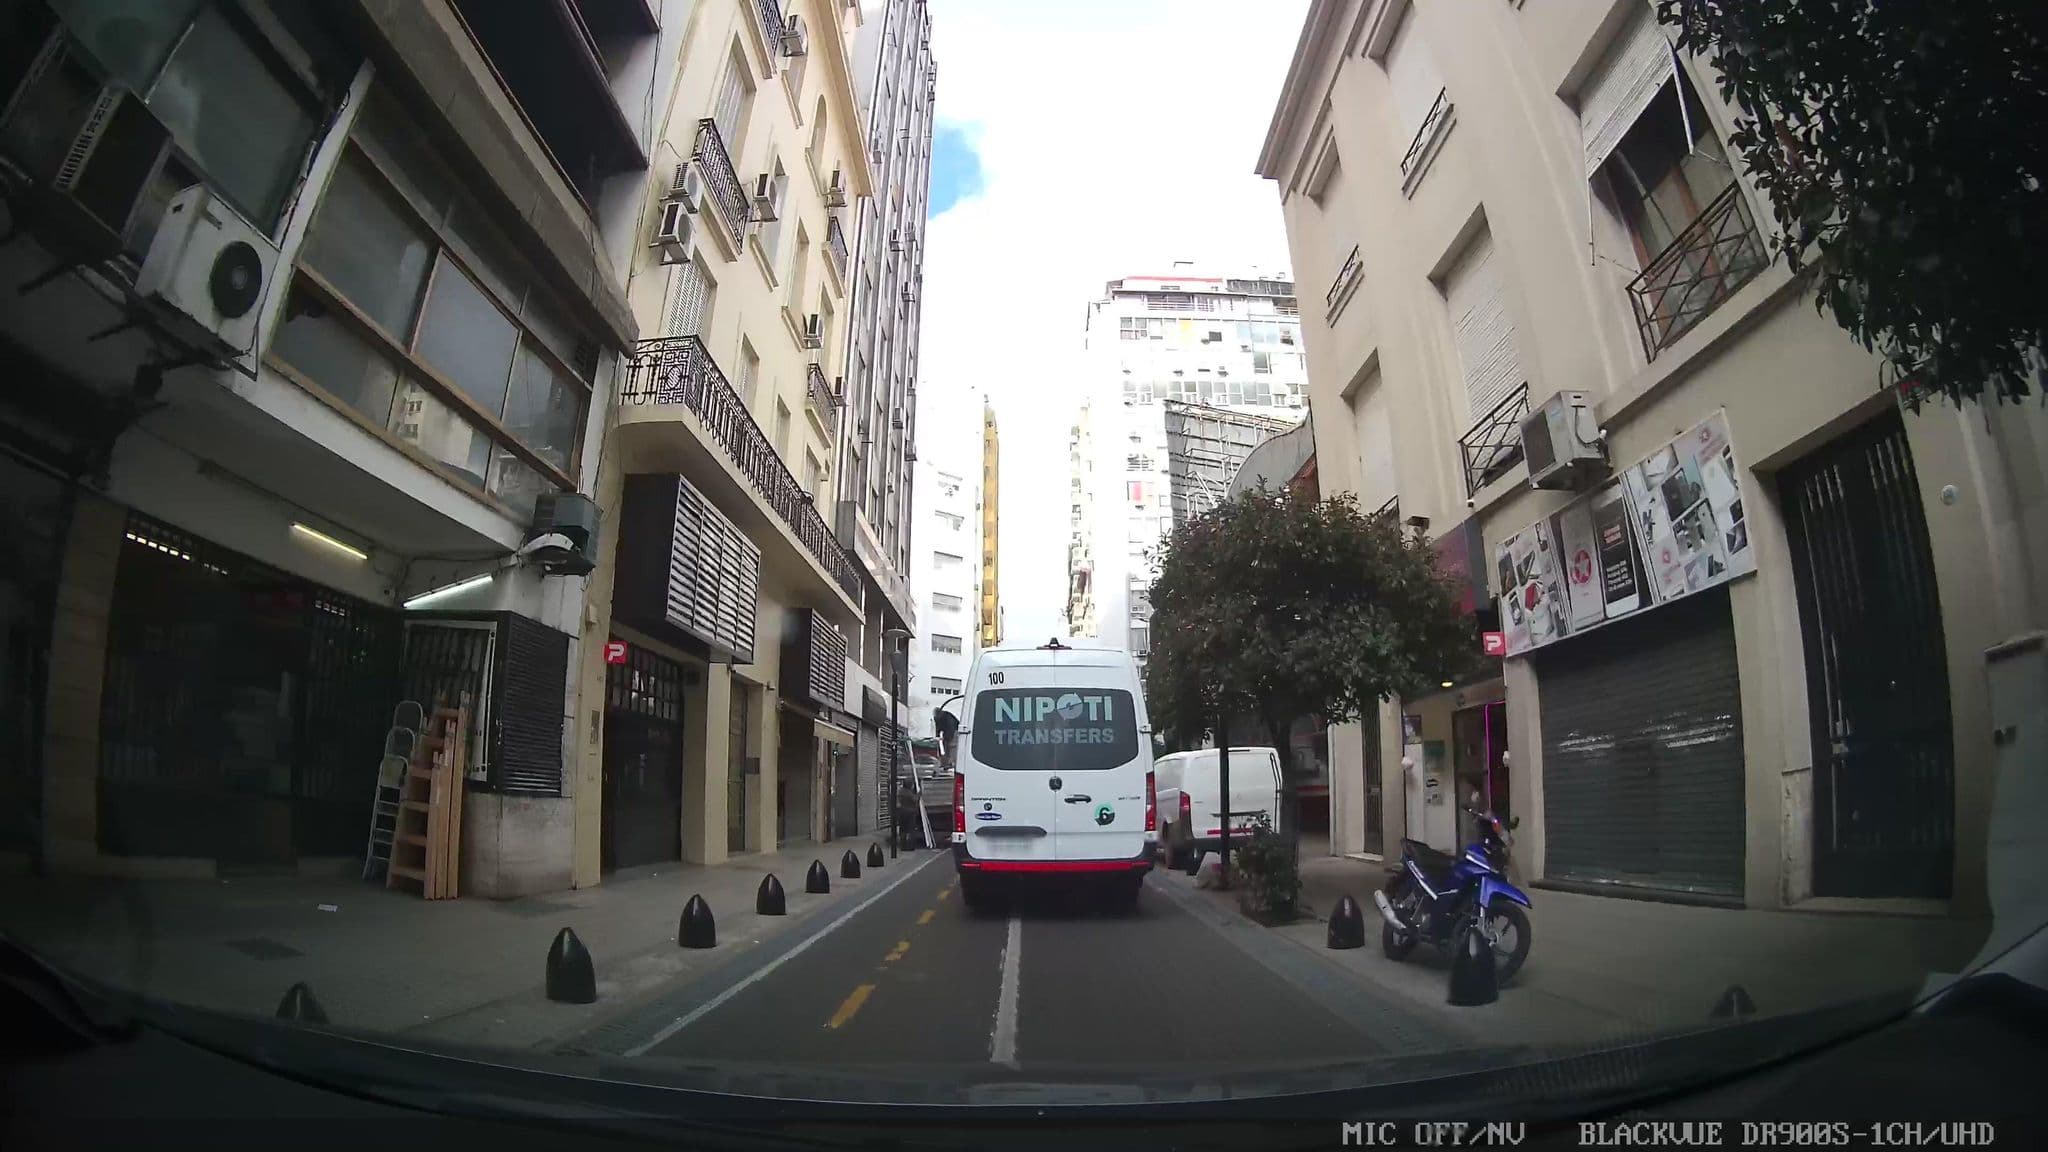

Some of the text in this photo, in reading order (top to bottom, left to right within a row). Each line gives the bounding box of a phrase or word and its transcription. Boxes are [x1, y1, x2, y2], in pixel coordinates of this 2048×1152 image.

[988, 671, 1005, 686] 100
[995, 692, 1113, 723] NIPOTI
[994, 727, 1115, 745] TRANSFERS
